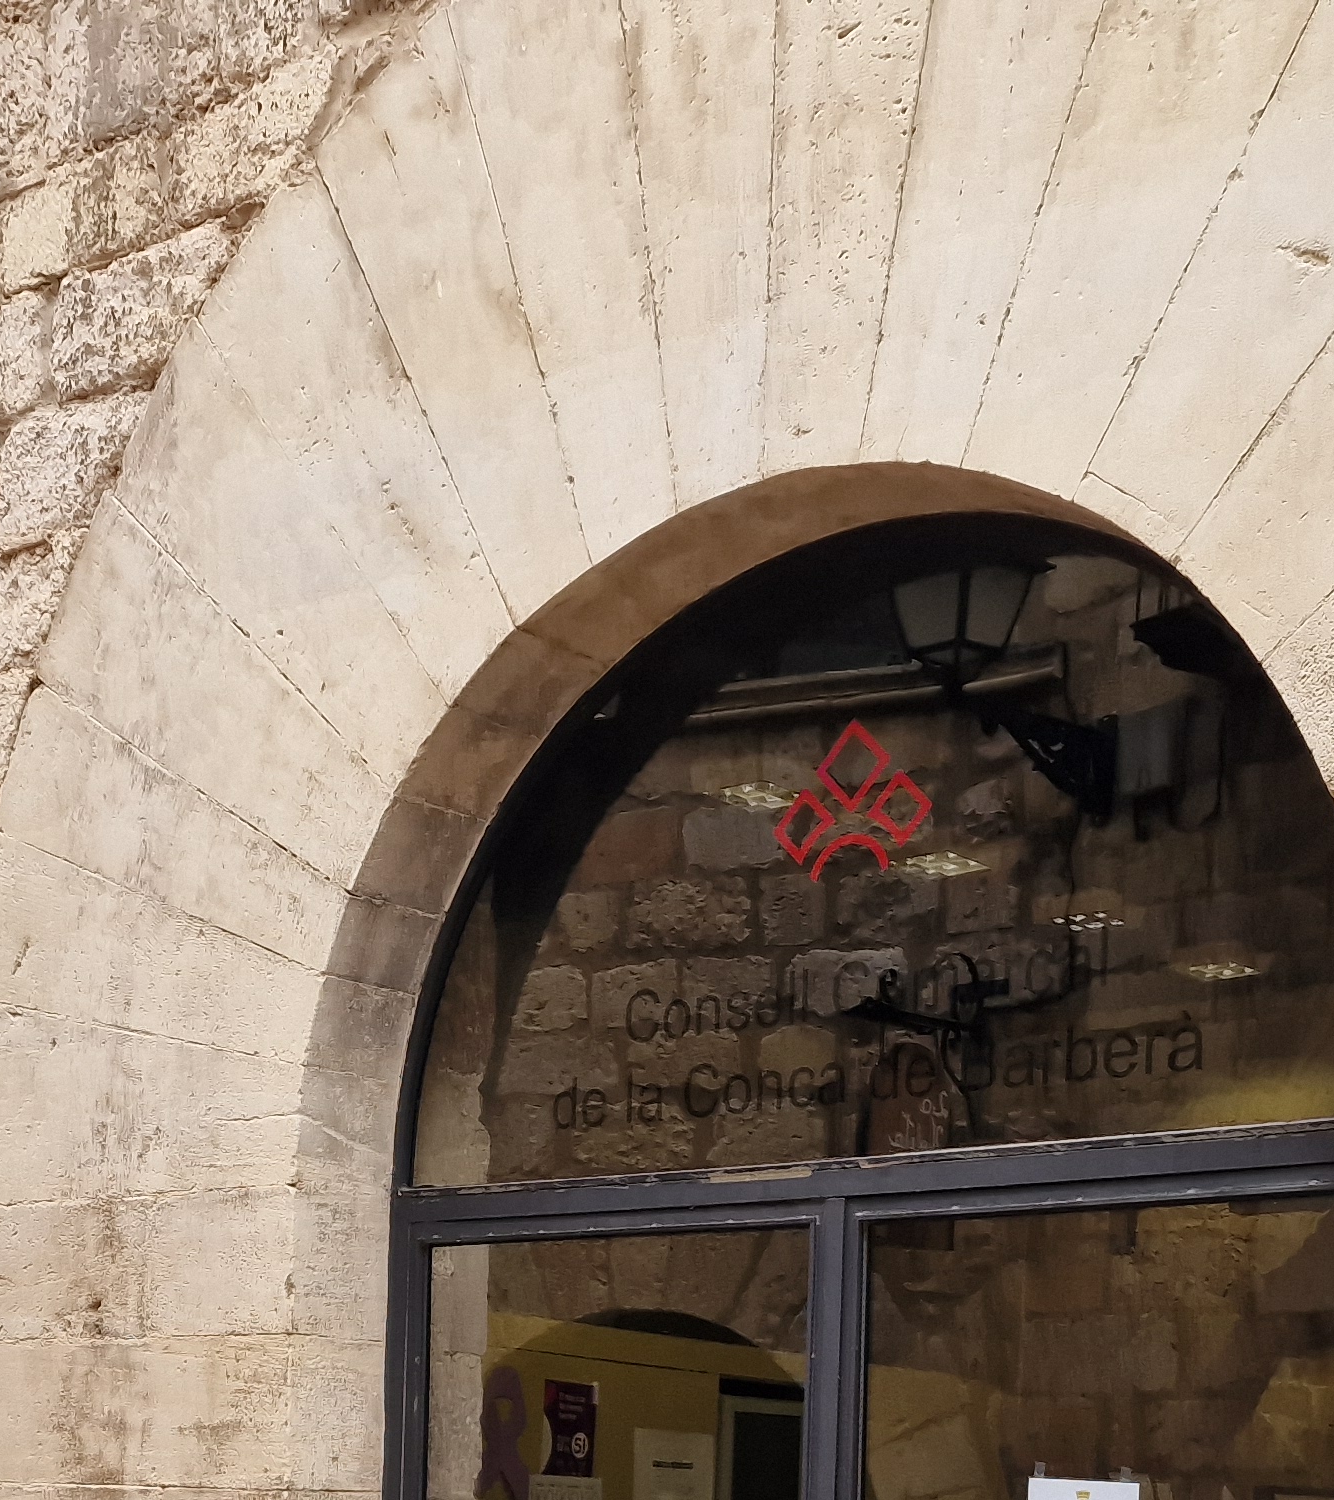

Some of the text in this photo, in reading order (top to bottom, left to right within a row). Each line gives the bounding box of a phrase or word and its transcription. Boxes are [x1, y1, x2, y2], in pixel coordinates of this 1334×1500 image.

[626, 967, 808, 1043] Consell
[553, 1010, 1204, 1130] de la Conca de Barberà
